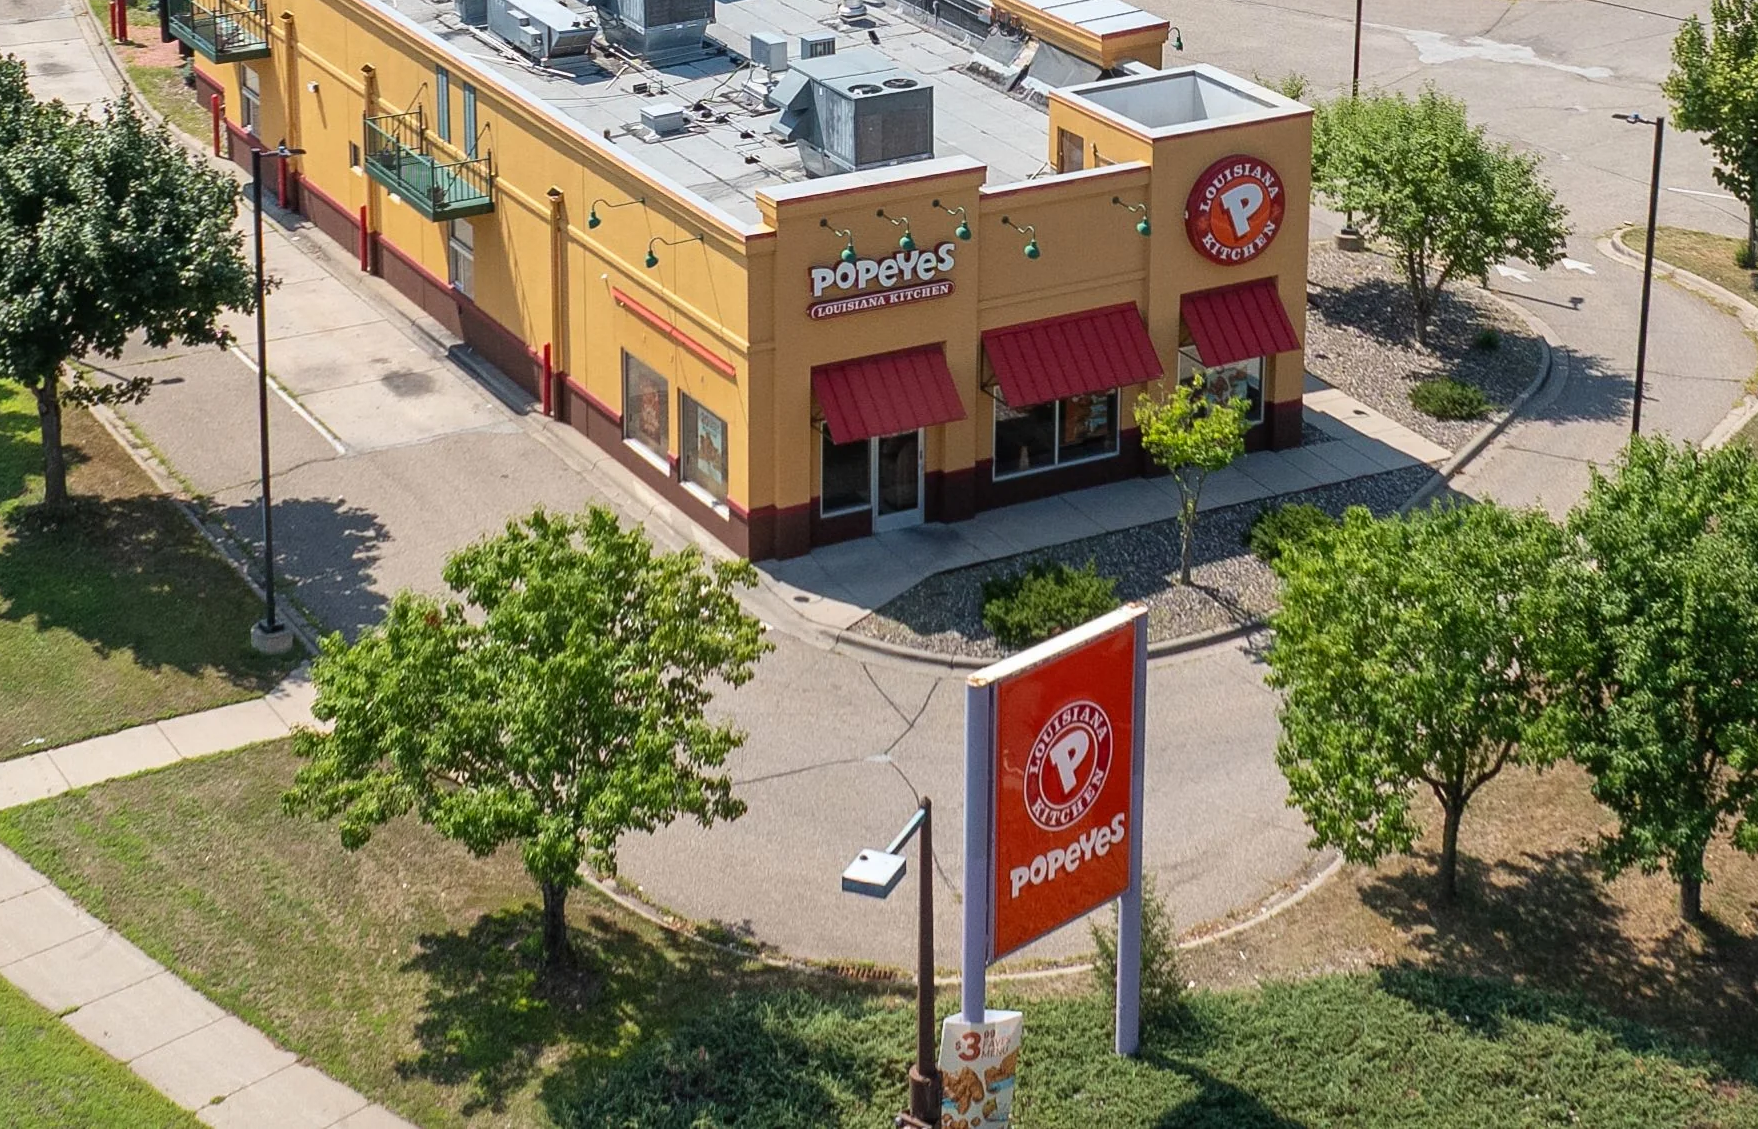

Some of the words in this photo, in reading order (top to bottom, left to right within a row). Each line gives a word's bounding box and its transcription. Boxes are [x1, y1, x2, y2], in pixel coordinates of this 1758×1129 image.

[1200, 164, 1279, 212] LOUISIANA
[1221, 182, 1263, 238] P
[1202, 220, 1275, 260] KITCHEN
[817, 297, 886, 317] LOUISIANA
[889, 284, 950, 303] KITCHEN
[1029, 706, 1108, 775] LOUISIANA
[1049, 729, 1090, 795] P
[1031, 769, 1104, 827] KITCHEN
